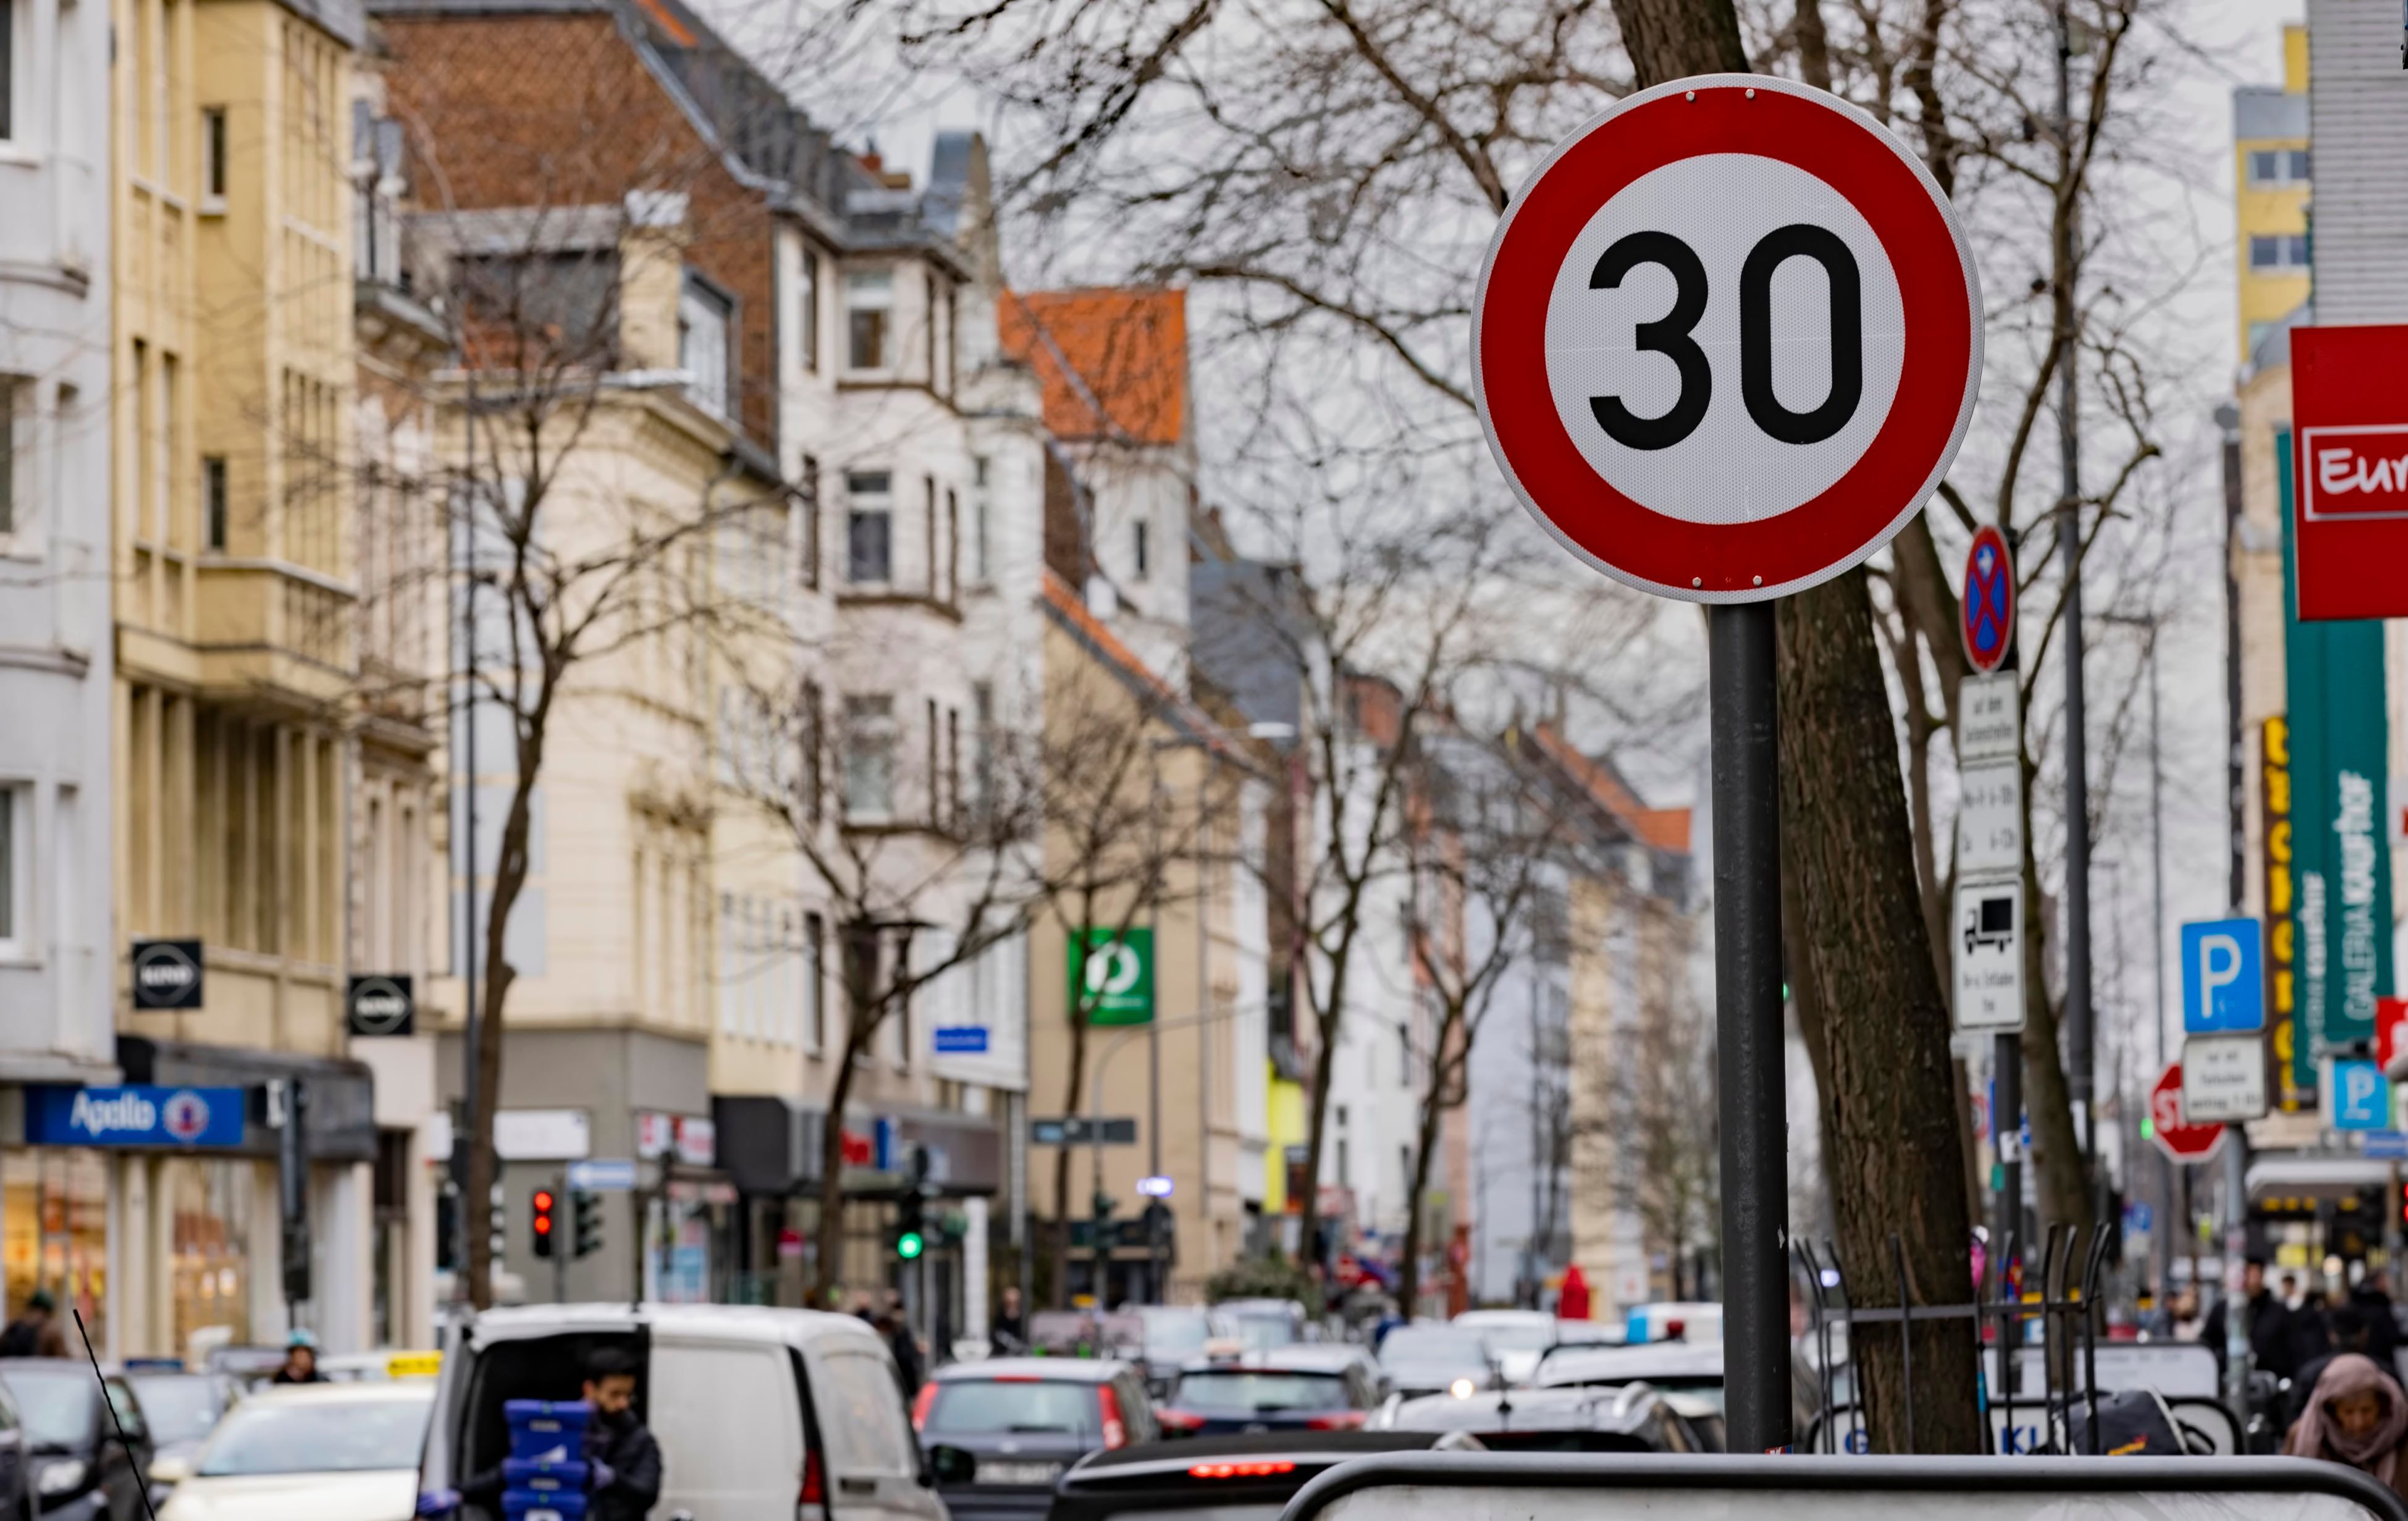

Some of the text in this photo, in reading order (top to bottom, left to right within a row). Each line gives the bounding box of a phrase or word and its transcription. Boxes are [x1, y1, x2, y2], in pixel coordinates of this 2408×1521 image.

[1589, 224, 1863, 450] 30
[2200, 935, 2241, 1018] P
[70, 1090, 156, 1136] Apollo
